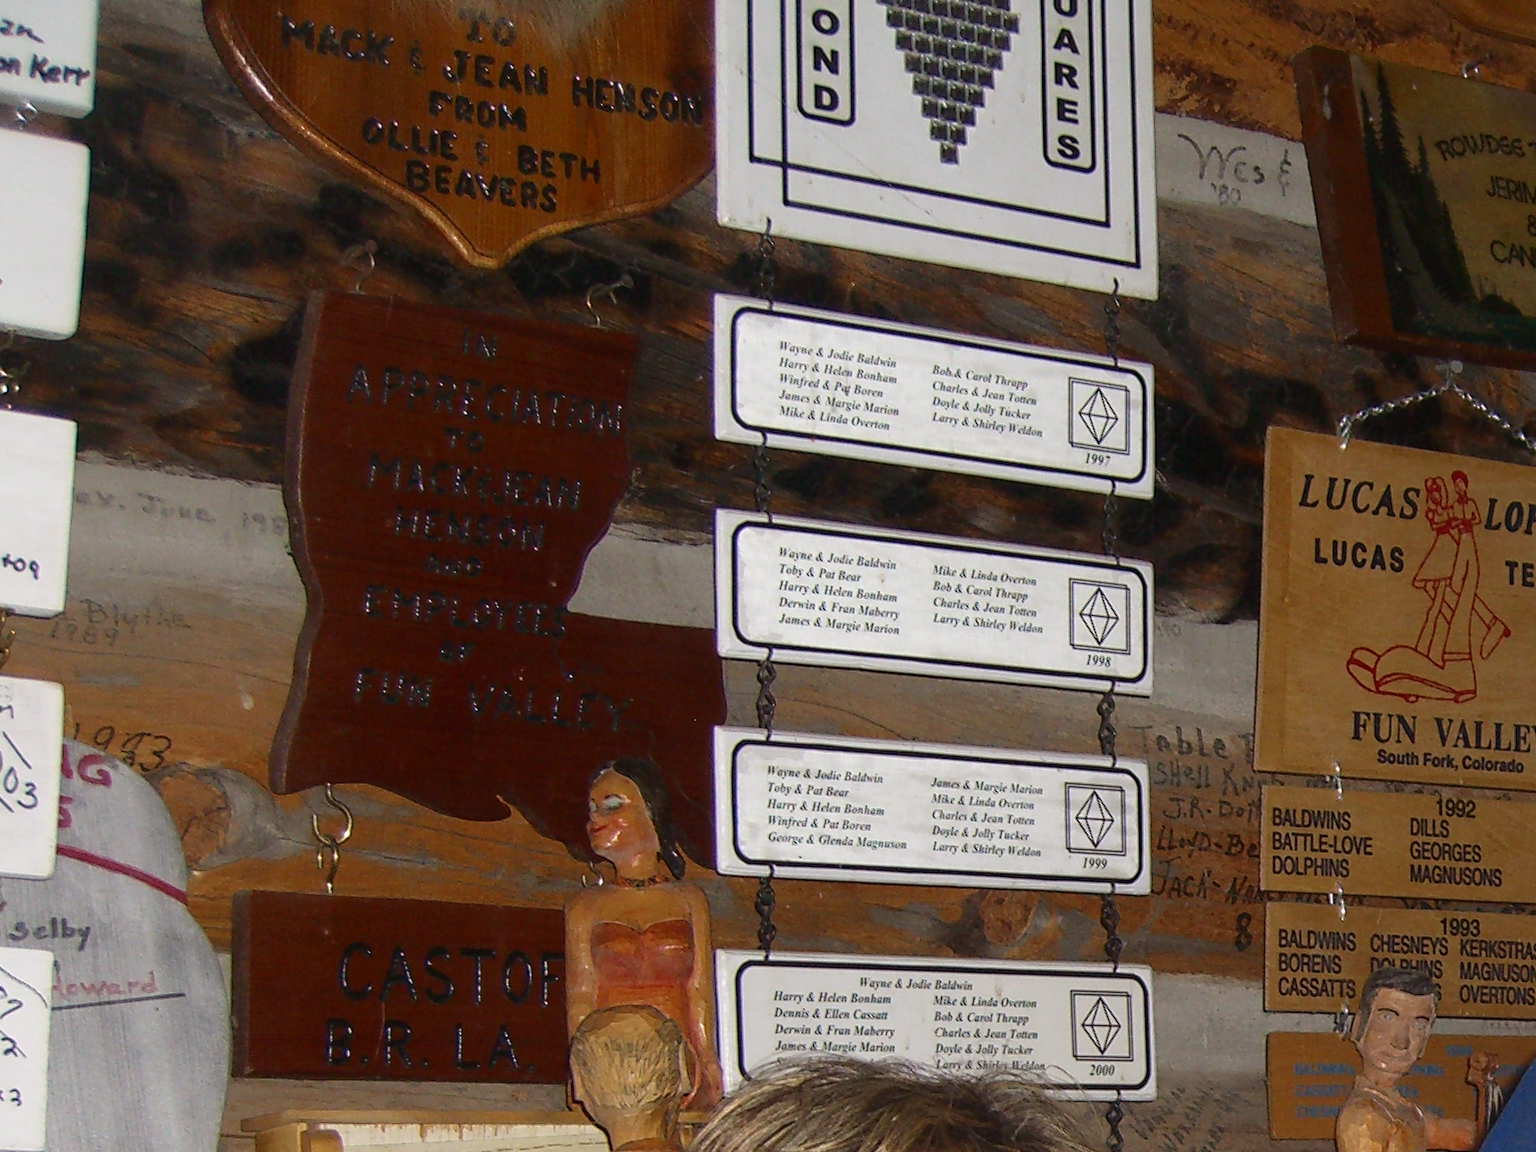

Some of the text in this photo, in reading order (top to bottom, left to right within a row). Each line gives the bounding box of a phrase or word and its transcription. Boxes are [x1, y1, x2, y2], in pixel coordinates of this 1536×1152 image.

[458, 8, 516, 48] TO
[280, 16, 394, 68] MACK
[442, 49, 549, 96] JEAN
[571, 73, 703, 127] HENSON
[428, 90, 527, 132] FROM
[361, 115, 459, 161] OLLIE
[517, 144, 600, 184] BETH
[1435, 133, 1526, 162] ROWDEE
[404, 159, 558, 213] BEAVERS
[779, 341, 814, 357] Wayne
[827, 348, 854, 362] Jodie
[857, 353, 897, 369] Baldwin
[779, 357, 809, 373] Harry
[823, 364, 854, 378] Helen
[856, 369, 898, 384] Bonham
[932, 364, 952, 377] Bob
[965, 369, 992, 384] Carol
[994, 374, 1029, 390] Thrapp
[345, 364, 624, 435] APPRECIATION
[779, 373, 820, 390] Winfred
[854, 384, 884, 398] Boren
[932, 380, 969, 396] Charles
[982, 388, 1005, 402] Jean
[1008, 393, 1038, 406] Totten
[779, 389, 811, 404] James
[824, 396, 861, 412] Margie
[864, 402, 900, 417] Marion
[931, 396, 960, 412] Doyle
[973, 403, 996, 418] Jolly
[999, 407, 1032, 421] Tucker
[779, 405, 805, 419] Mike
[819, 411, 849, 425] Linda
[851, 416, 891, 431] Overton
[931, 412, 958, 428] Larry
[973, 417, 1007, 435] Shirley
[1009, 423, 1044, 438] Weldon
[1084, 452, 1112, 467] 1997
[1298, 473, 1421, 521] LUCAS
[393, 505, 546, 553] HENSON
[1314, 537, 1405, 573] LUCAS
[363, 584, 567, 640] EMPLOYEES
[1086, 654, 1112, 668] 1998
[353, 668, 634, 732] FUN VALLEY
[1351, 711, 1418, 745] FUN
[1377, 749, 1525, 774] South Fork, Colorado
[1272, 807, 1352, 831] BALDWINS
[1410, 817, 1451, 838] DILLS
[1436, 799, 1477, 820] 1992
[1272, 831, 1373, 856] BATTLE-LOVE
[1410, 840, 1482, 864] GEORGES
[1082, 857, 1108, 870] 1999
[1272, 855, 1350, 878] DOLPHINS
[1410, 863, 1503, 888] MAGNUSONS
[1439, 917, 1481, 938] 1993
[1278, 929, 1357, 952] BALDWINS
[1369, 933, 1449, 957] CHESNEYS
[1278, 953, 1342, 974] BORENS
[1278, 976, 1536, 1007] CASSATTS OVERTONS
[774, 1007, 810, 1019] Dennis
[824, 1008, 850, 1019] Ellen
[853, 1009, 888, 1020] Cassatt
[1089, 1064, 1116, 1076] 2000
